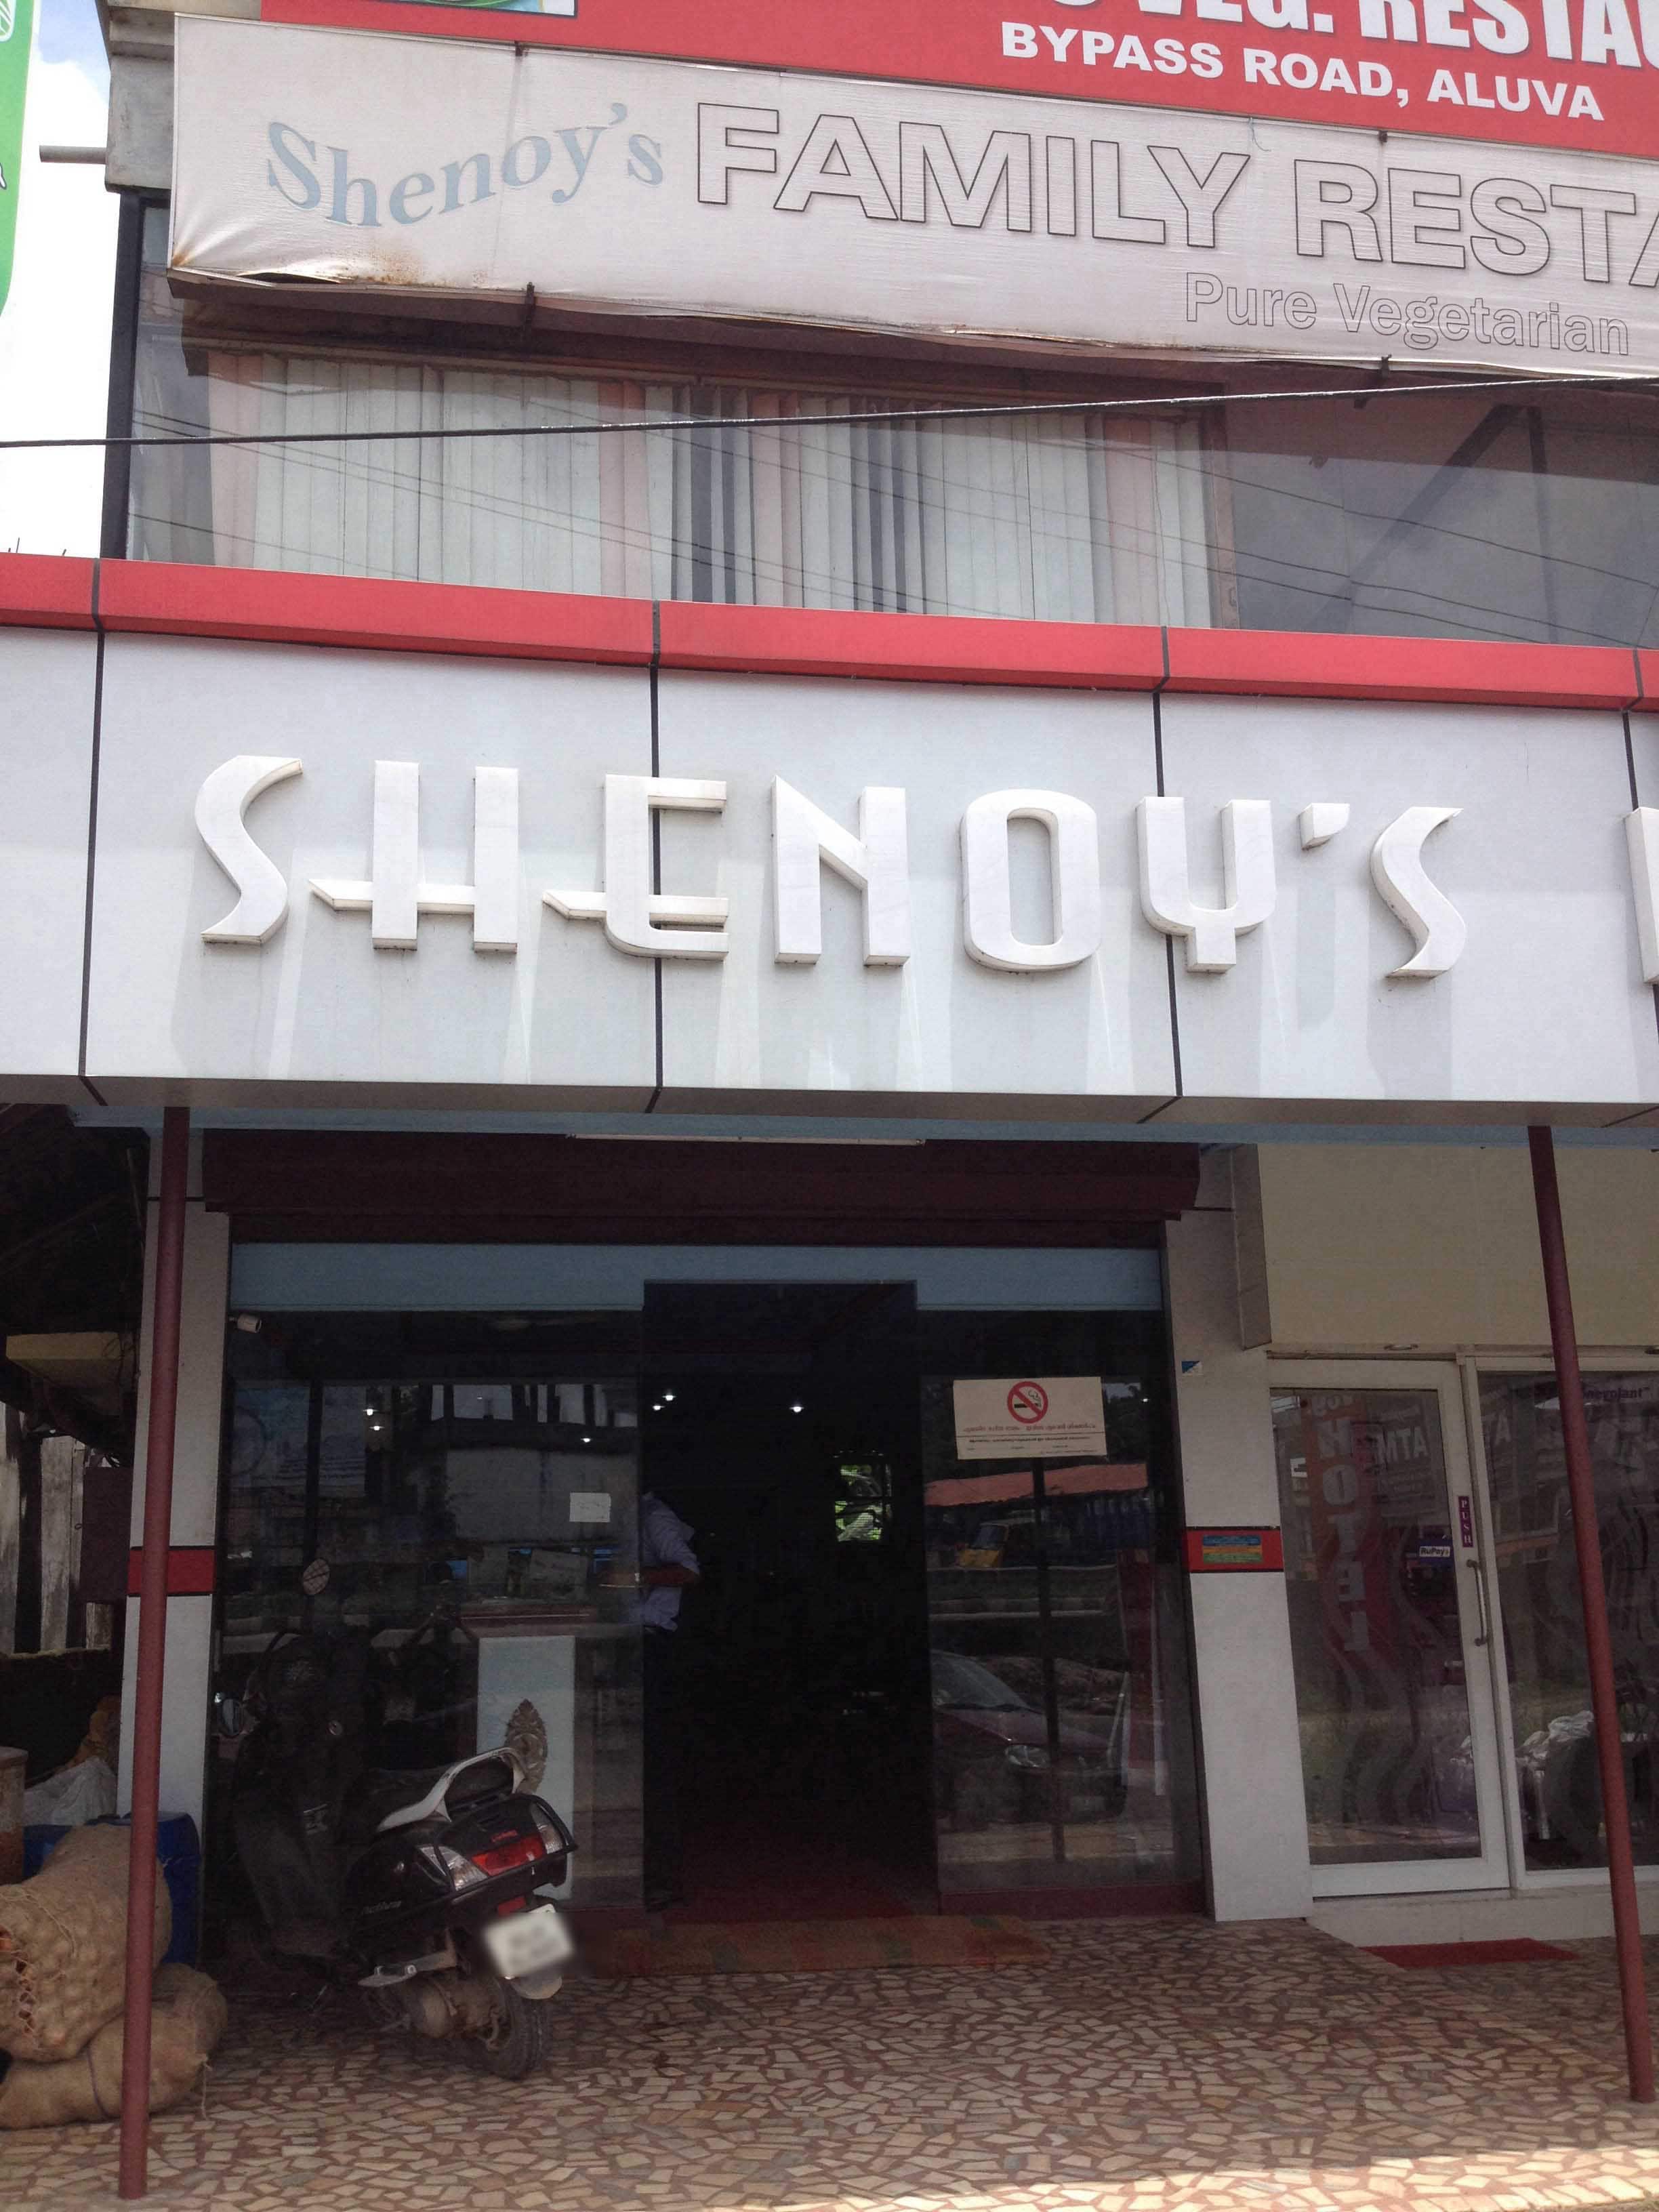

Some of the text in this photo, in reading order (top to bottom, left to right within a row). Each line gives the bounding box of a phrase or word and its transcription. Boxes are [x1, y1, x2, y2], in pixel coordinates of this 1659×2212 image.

[1002, 21, 1605, 121] BYPASS ROAD, ALUVA
[266, 102, 1659, 287] Shenoy's FAMILY REST
[1186, 272, 1629, 356] Pure Vegetarian
[194, 754, 1467, 979] SHENOY'S
[1420, 1547, 1446, 1557] RuPay
[1460, 1500, 1472, 1544] PUSH
